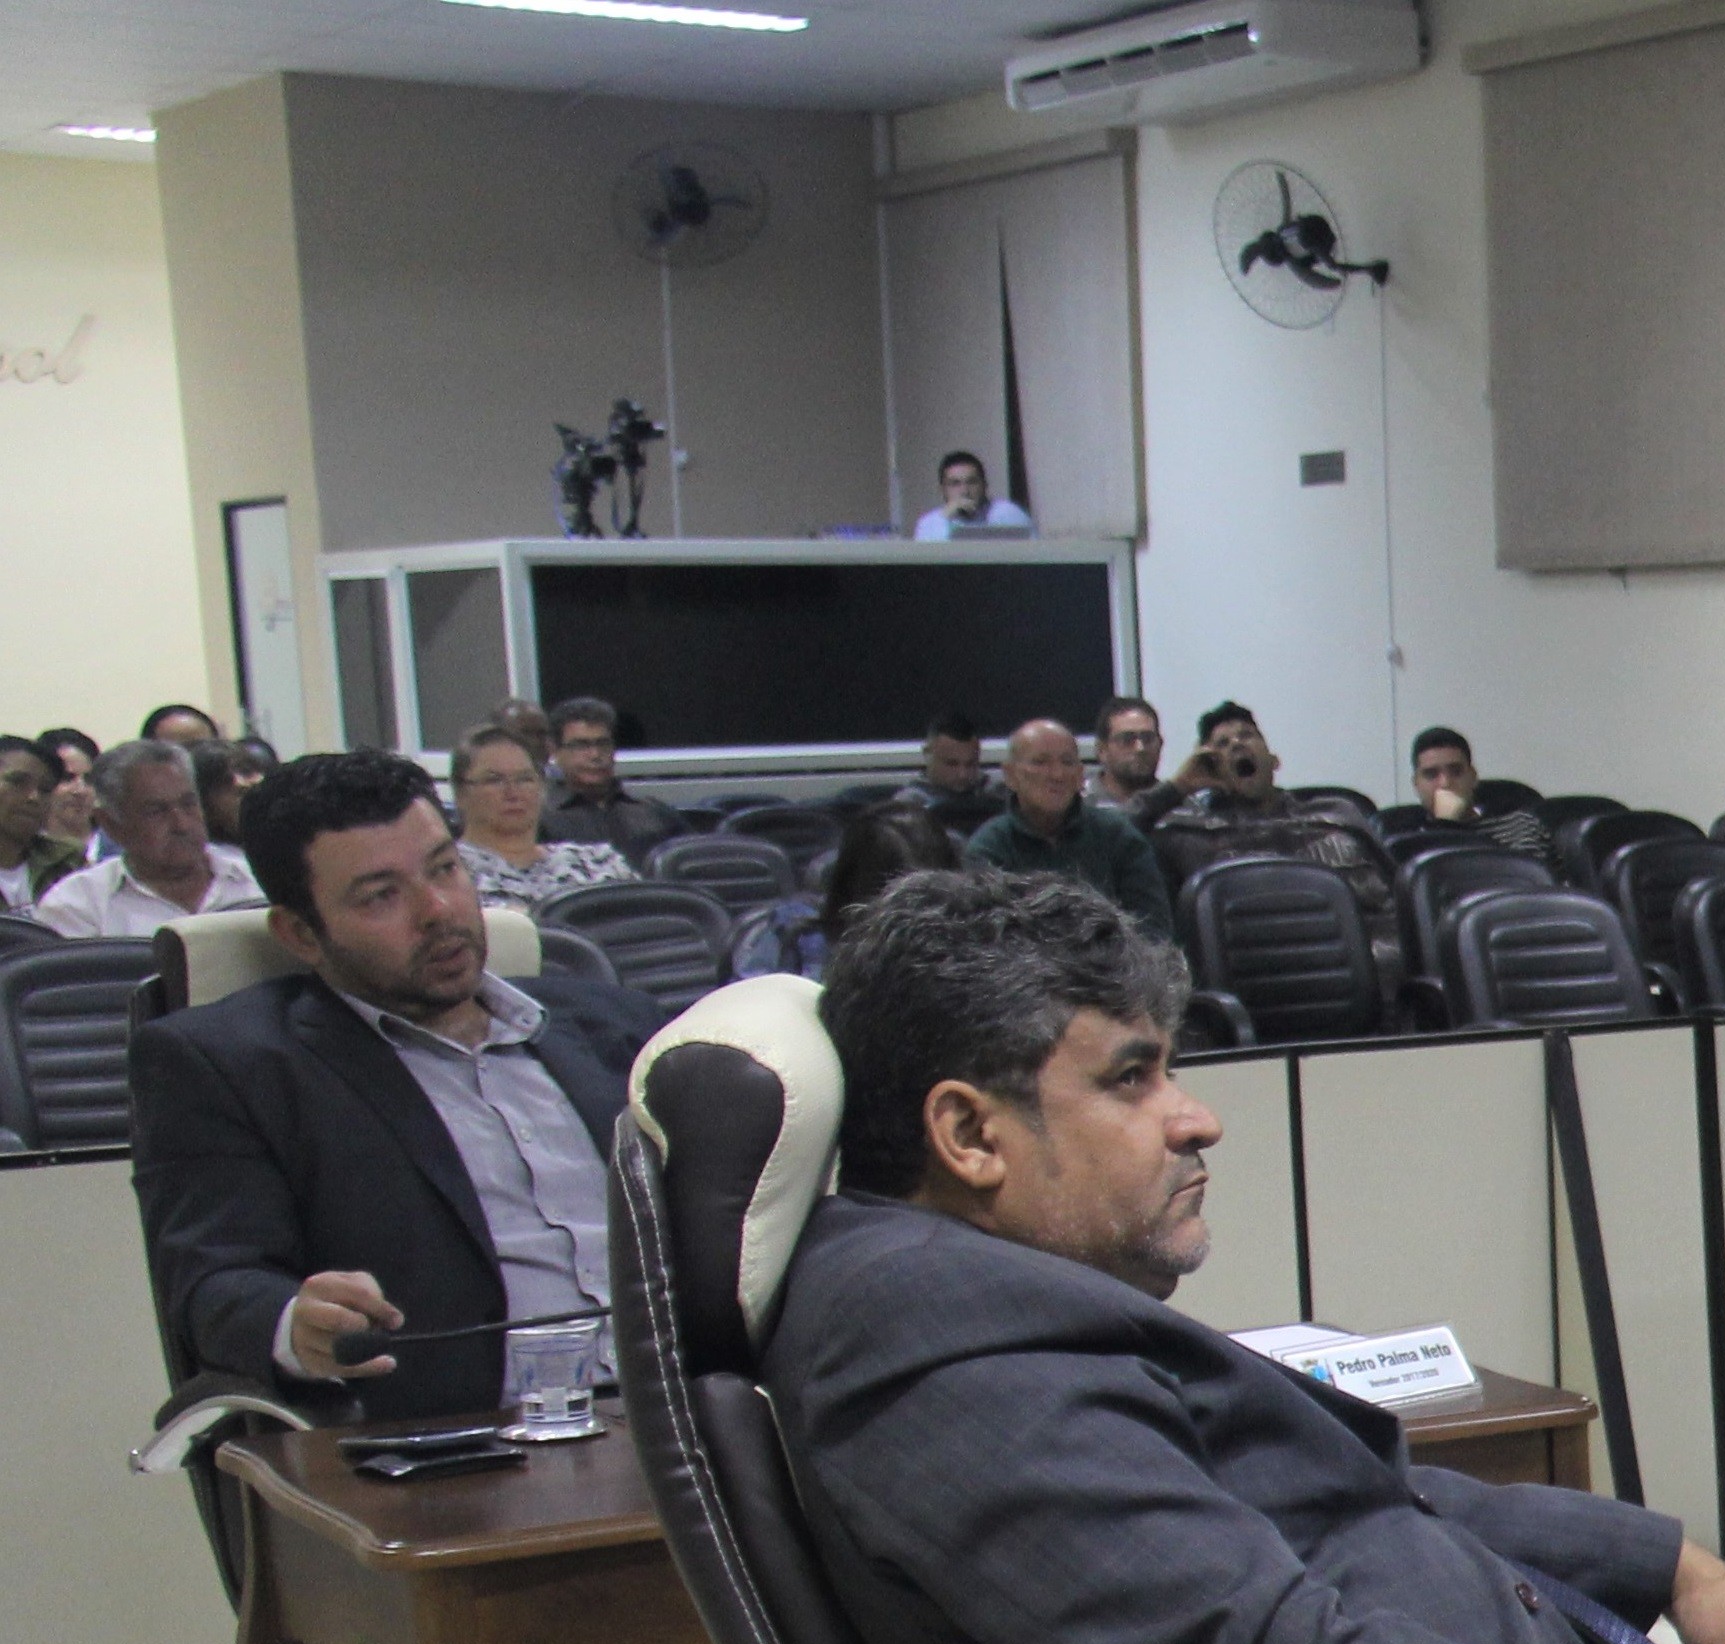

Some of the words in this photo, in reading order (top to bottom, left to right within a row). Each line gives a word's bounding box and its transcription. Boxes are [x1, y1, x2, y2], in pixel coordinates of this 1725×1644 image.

[1336, 1358, 1376, 1375] Pedro
[1377, 1351, 1419, 1368] Palma
[1420, 1343, 1452, 1360] Neto
